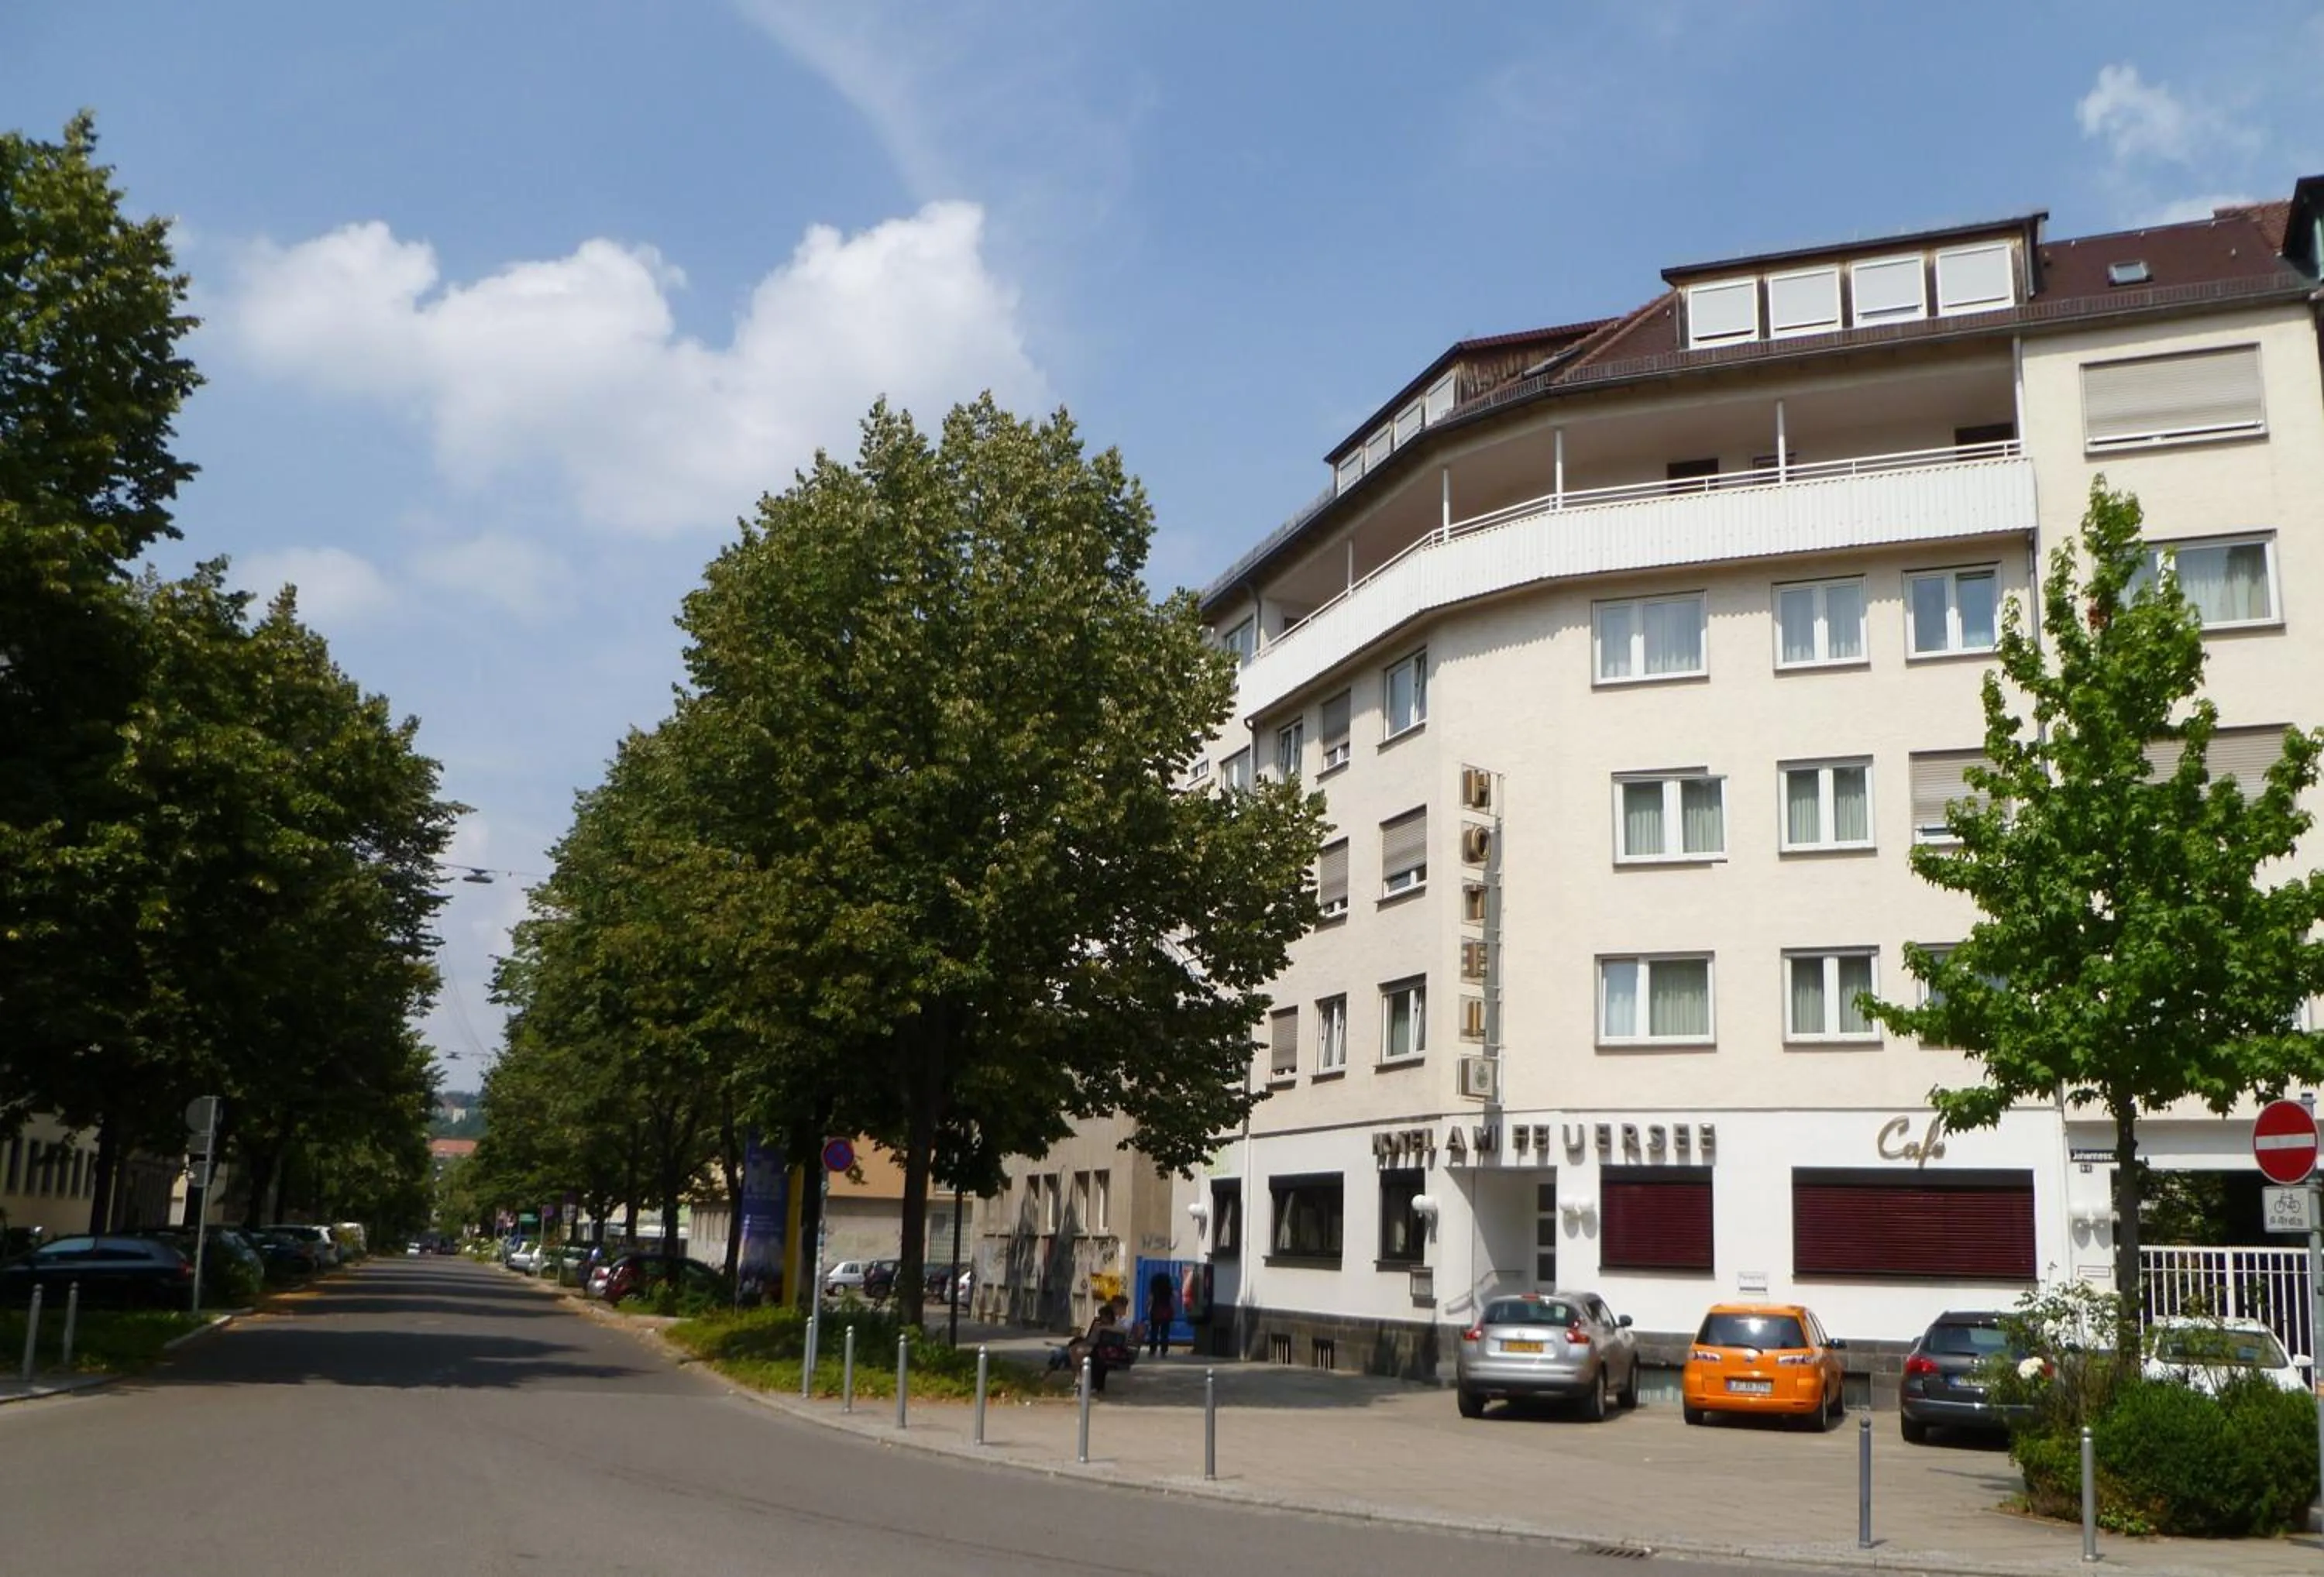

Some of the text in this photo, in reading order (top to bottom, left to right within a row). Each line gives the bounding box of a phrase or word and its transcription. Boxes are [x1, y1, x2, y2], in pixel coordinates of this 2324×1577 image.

[1462, 768, 1490, 1036] HOTEL
[1446, 1125, 1498, 1153] AM
[1512, 1123, 1716, 1151] FEUERSEE
